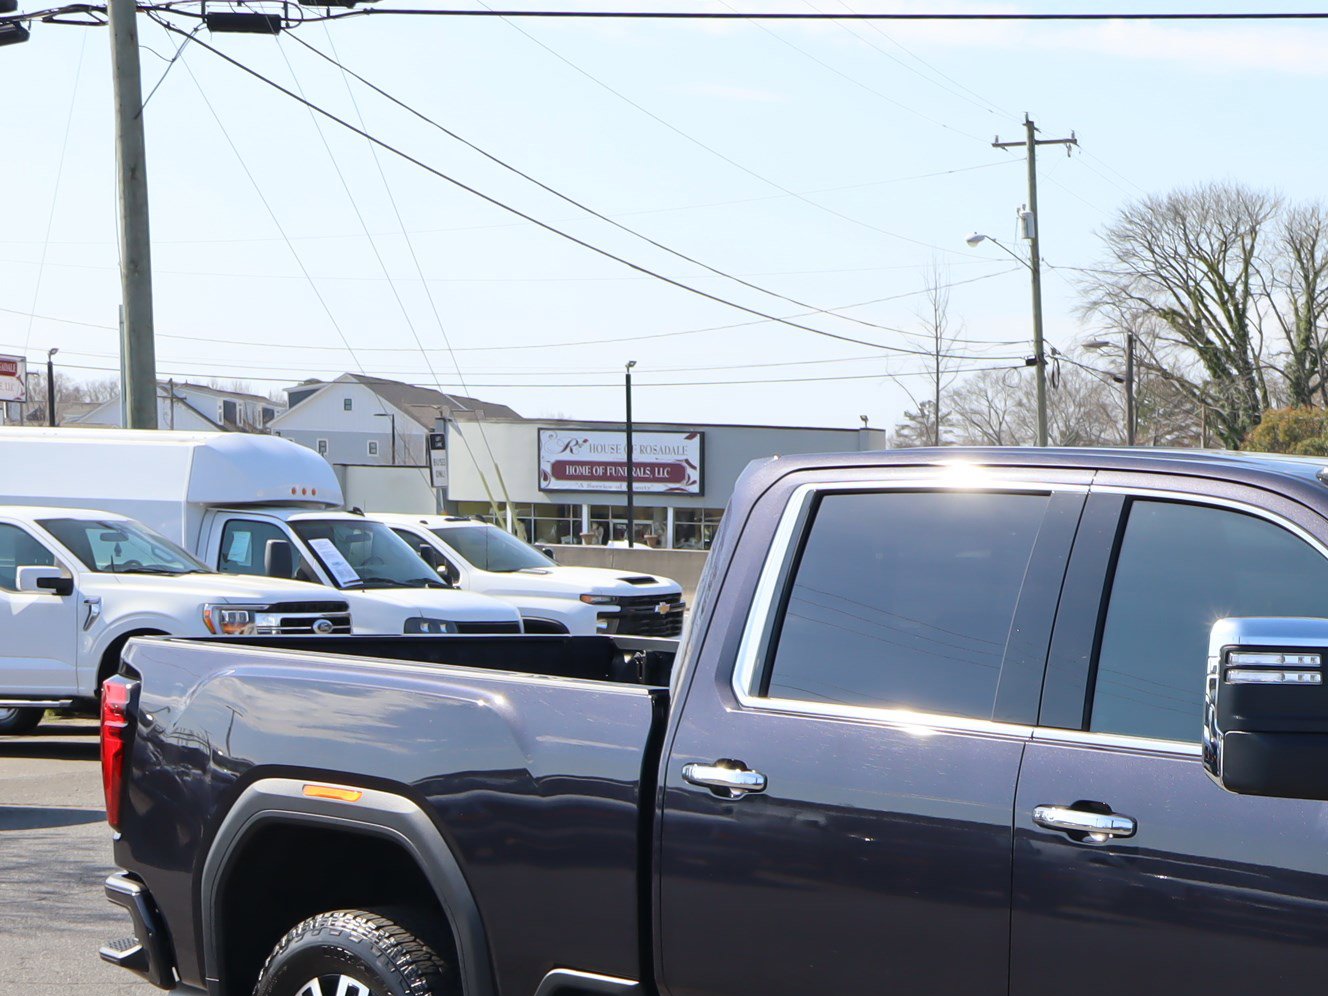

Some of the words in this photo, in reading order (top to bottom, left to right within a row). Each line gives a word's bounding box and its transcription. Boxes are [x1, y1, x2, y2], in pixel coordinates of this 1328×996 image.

[589, 443, 622, 455] HOUSE
[640, 444, 688, 457] ROSADALE
[565, 464, 591, 476] HOME
[592, 465, 605, 476] OF
[655, 467, 671, 478] LLC
